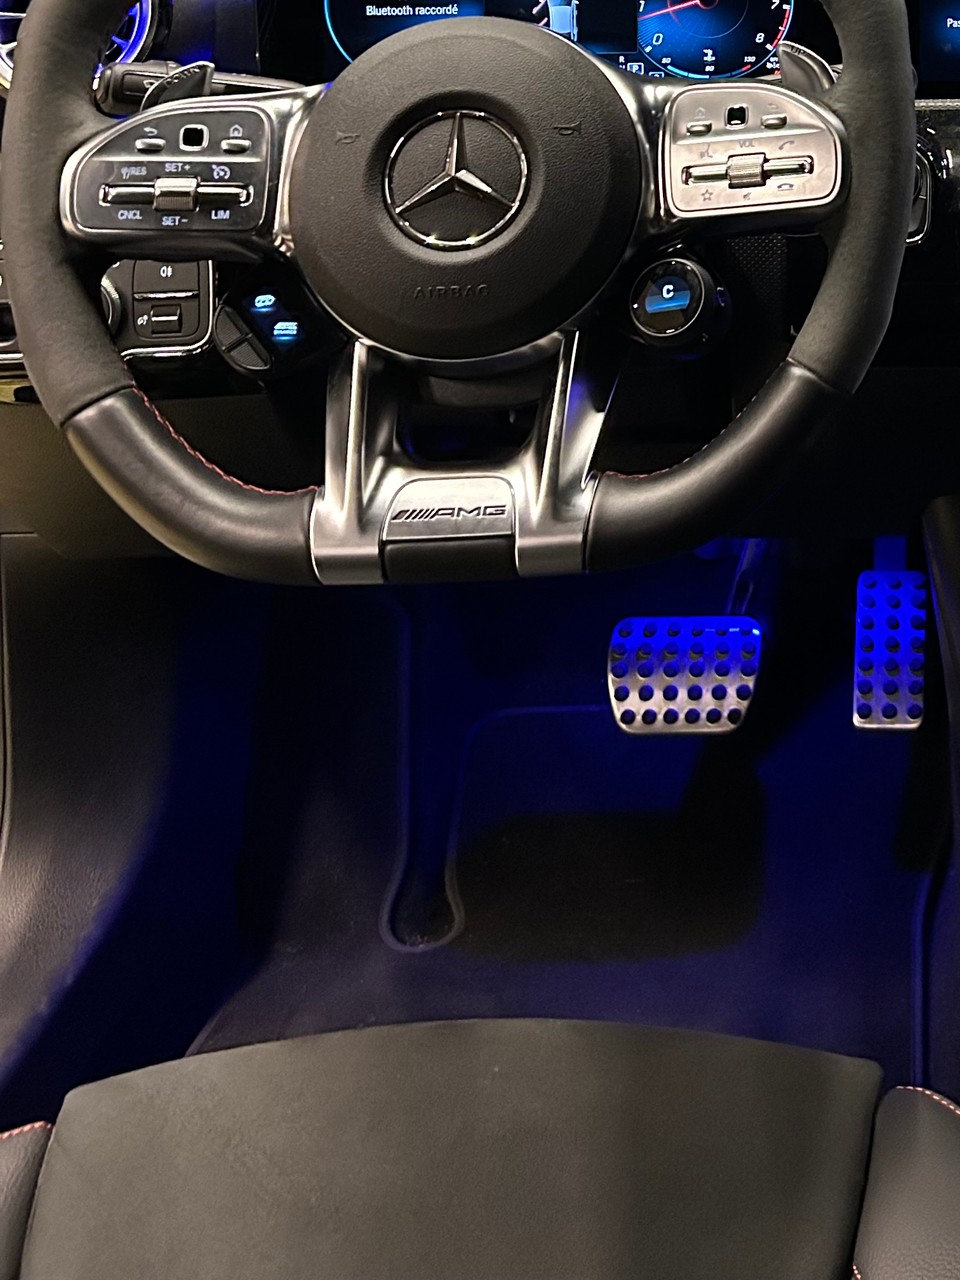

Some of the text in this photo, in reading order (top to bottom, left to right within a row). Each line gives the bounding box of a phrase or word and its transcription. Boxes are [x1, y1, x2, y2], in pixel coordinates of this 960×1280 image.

[365, 3, 459, 16] Bluetooth raccordé
[639, 0, 646, 12] 1
[770, 0, 780, 10] 7
[652, 33, 663, 45] 0
[755, 32, 765, 43] 8
[739, 140, 755, 148] VOL
[117, 209, 143, 220] CNCL
[211, 209, 230, 220] LIM
[413, 284, 489, 300] AIRBAG
[662, 284, 675, 299] C
